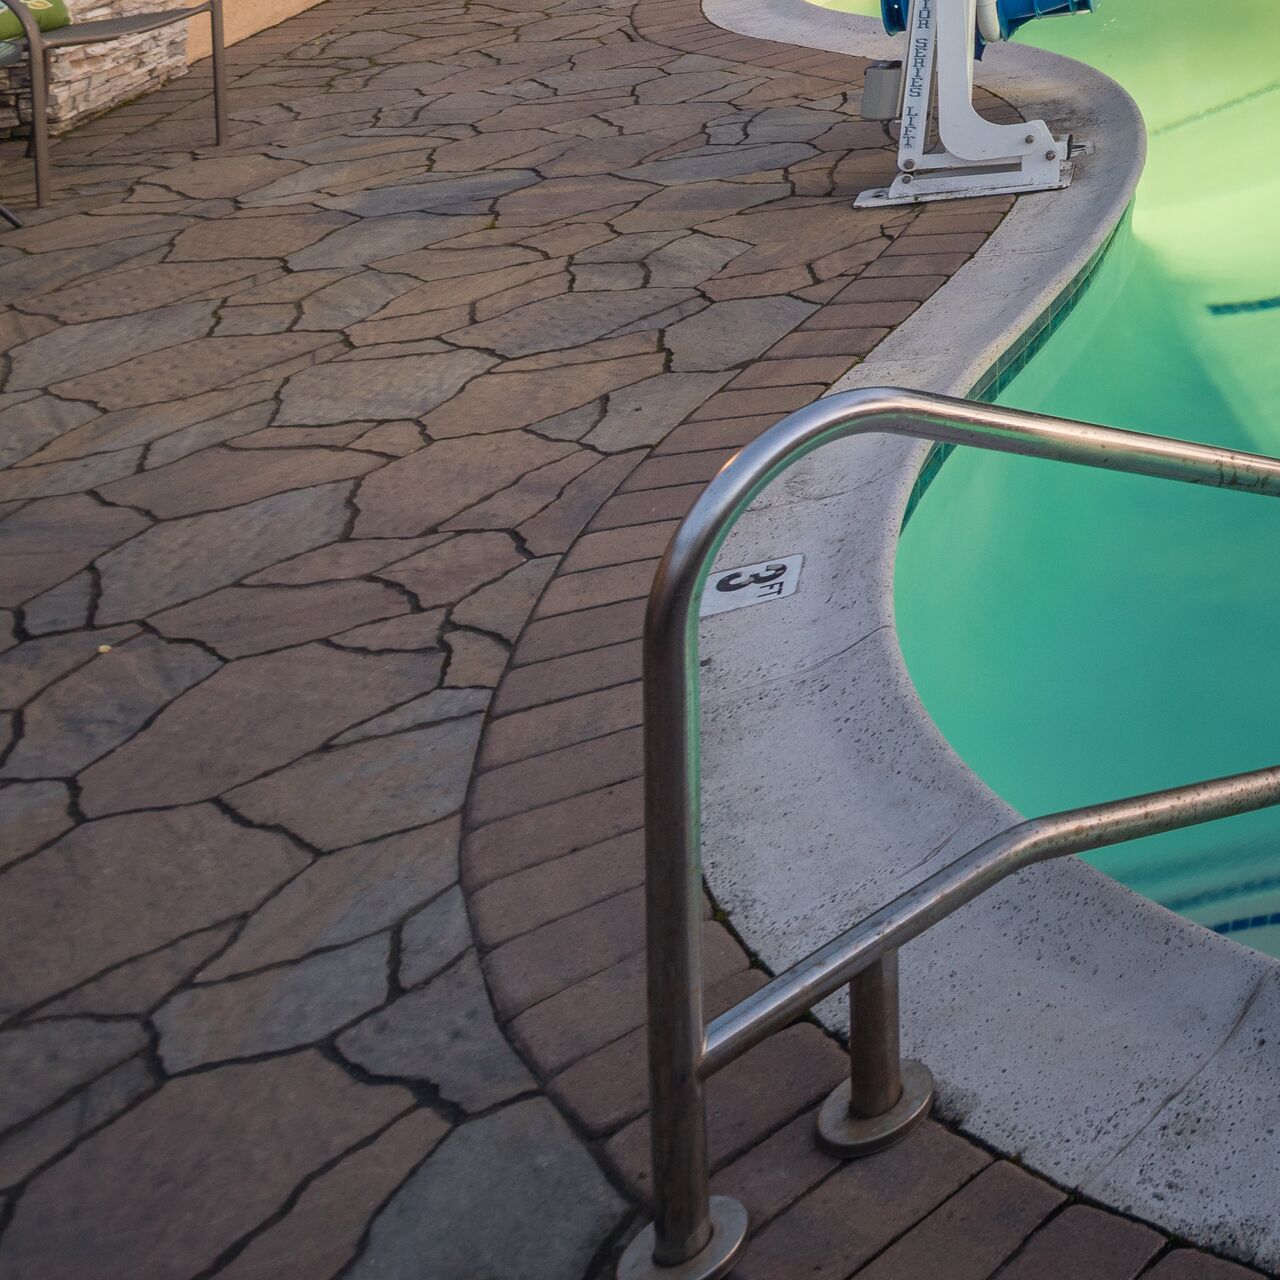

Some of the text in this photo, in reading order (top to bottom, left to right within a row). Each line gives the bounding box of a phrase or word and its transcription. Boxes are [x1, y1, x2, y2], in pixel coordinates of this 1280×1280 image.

[909, 38, 928, 98] SERIES
[903, 106, 918, 146] LIFT
[716, 563, 787, 598] 3 FT
